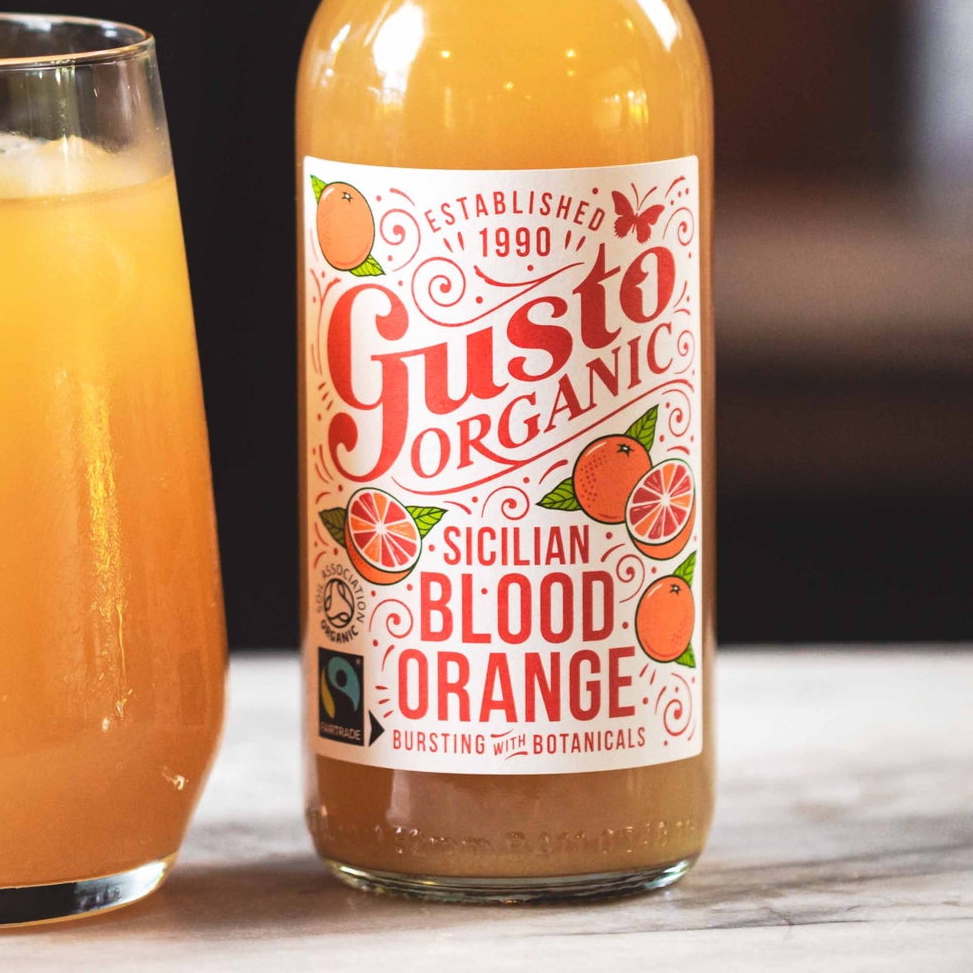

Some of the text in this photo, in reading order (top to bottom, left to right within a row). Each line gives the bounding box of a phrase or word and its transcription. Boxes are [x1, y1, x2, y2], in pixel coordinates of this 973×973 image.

[423, 190, 607, 233] ESTABLISHED
[478, 226, 552, 257] 1990
[327, 242, 677, 483] Gusto
[410, 321, 675, 479] ORGANIC
[443, 525, 591, 567] SICILIAN
[321, 563, 367, 624] ASSOCIATION
[419, 570, 615, 644] BLOOD
[321, 619, 359, 643] ORGANIC
[397, 645, 636, 723] ORANGE
[392, 726, 646, 756] BURSTING WITH BOTANICALS
